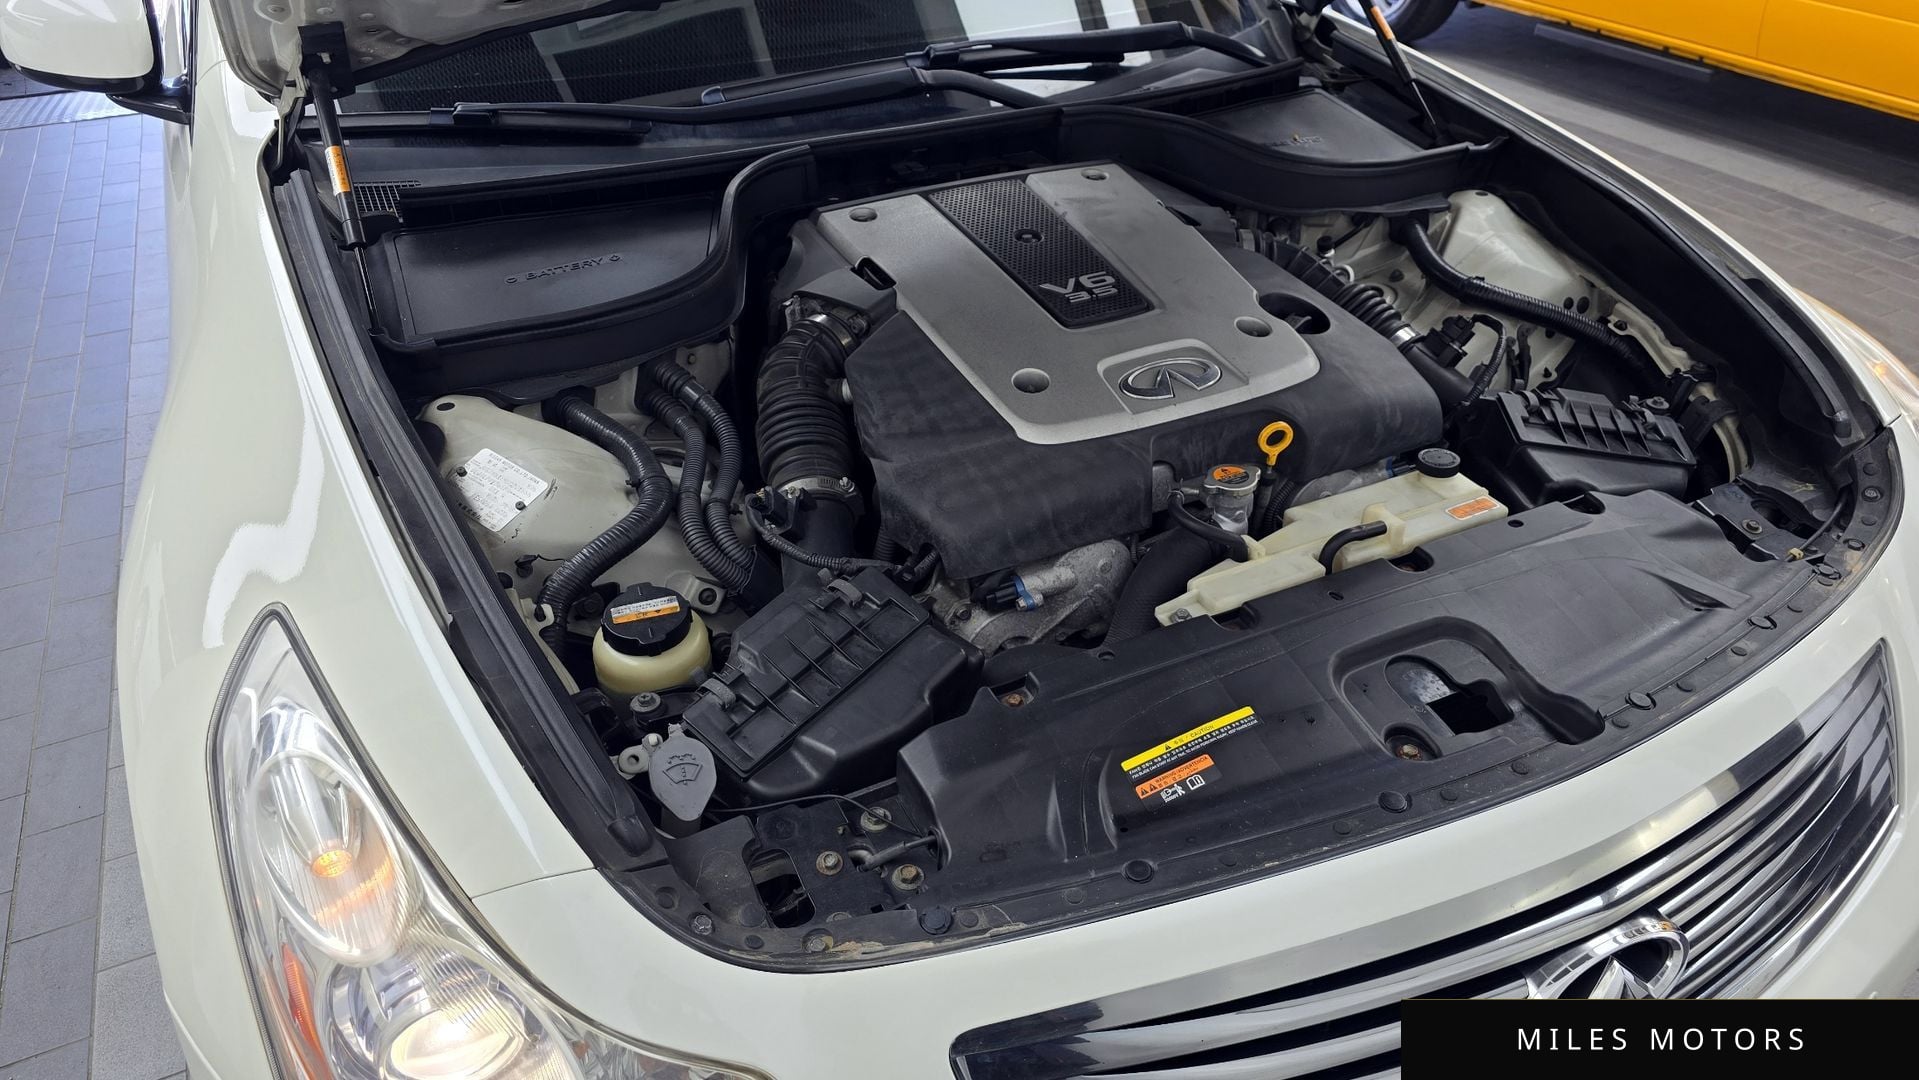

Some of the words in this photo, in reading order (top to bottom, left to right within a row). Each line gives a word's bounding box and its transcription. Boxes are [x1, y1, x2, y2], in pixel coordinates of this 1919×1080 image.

[525, 257, 603, 281] BATTERY
[1039, 271, 1116, 294] V6
[1064, 285, 1119, 303] 3.5
